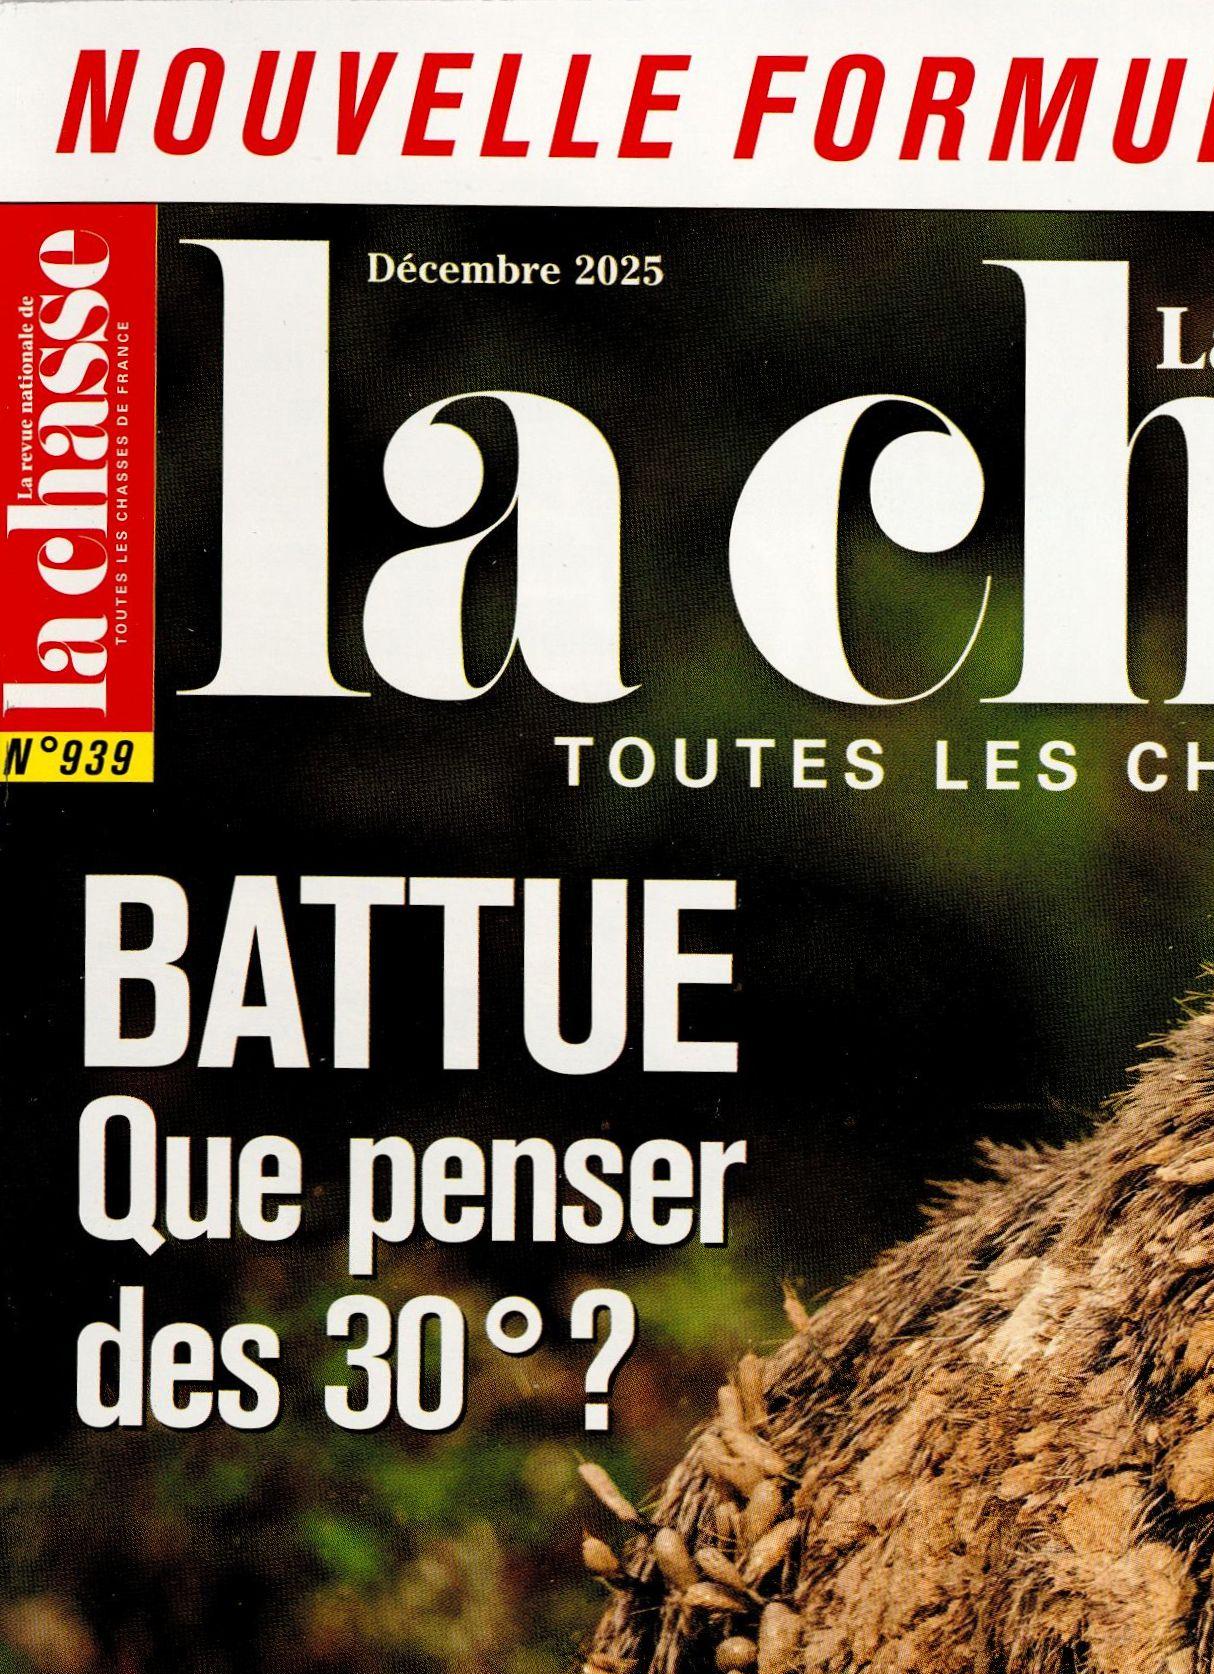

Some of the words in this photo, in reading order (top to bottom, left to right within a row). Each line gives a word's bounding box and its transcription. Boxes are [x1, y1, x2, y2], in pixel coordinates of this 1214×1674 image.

[57, 48, 691, 158] NOUVELLE
[18, 296, 34, 318] de
[368, 252, 560, 285] Décembre
[576, 254, 663, 286] 2025
[18, 322, 34, 414] nationale
[116, 321, 129, 394] FRANCE
[7, 229, 111, 595] chasse
[21, 418, 33, 472] revue
[116, 404, 128, 426] DE
[17, 476, 33, 499] La
[116, 435, 128, 521] CHASSES
[177, 238, 643, 704] la
[115, 530, 128, 562] LES
[115, 573, 128, 645] TOUTES
[3, 613, 108, 718] la
[555, 737, 883, 790] TOUTES
[937, 740, 1077, 792] LES
[84, 875, 738, 1074] BATTUE
[79, 1095, 302, 1256] Que
[349, 1137, 747, 1275] penser
[76, 1286, 280, 1428] des
